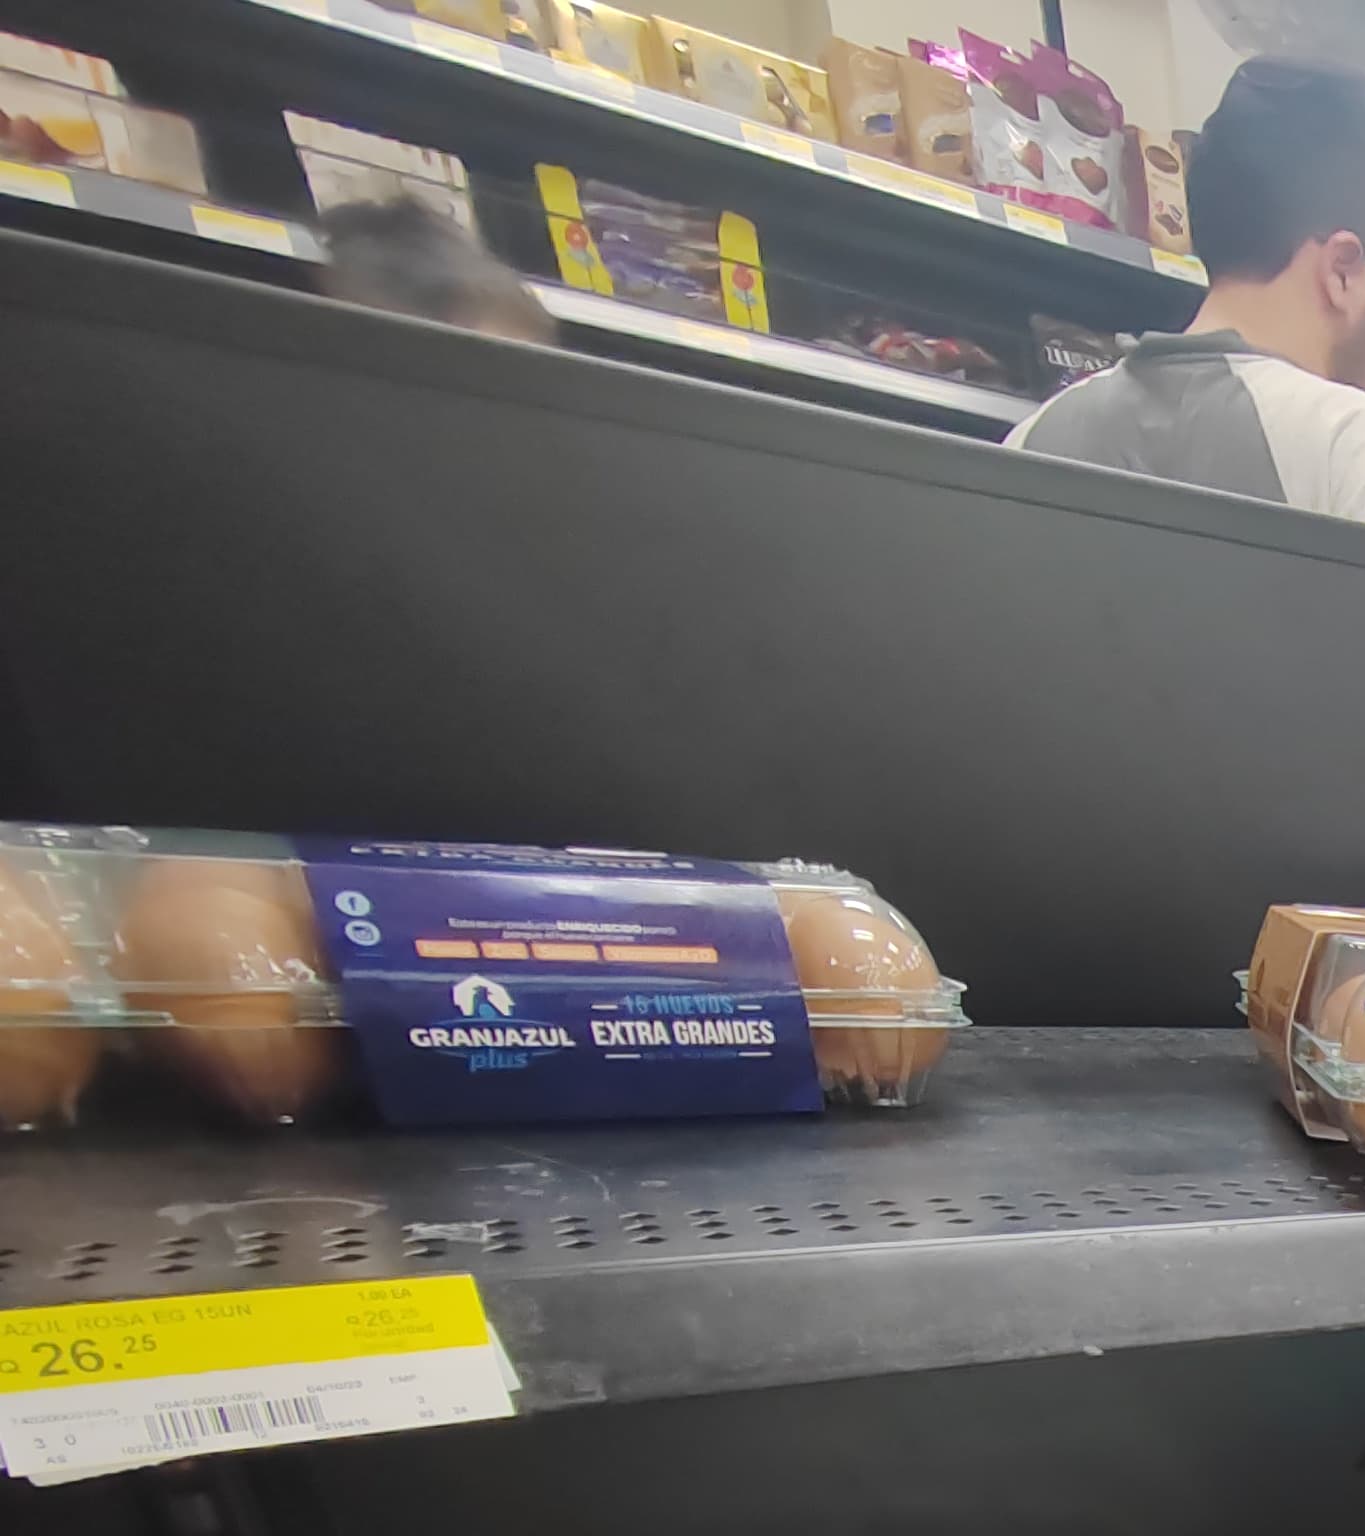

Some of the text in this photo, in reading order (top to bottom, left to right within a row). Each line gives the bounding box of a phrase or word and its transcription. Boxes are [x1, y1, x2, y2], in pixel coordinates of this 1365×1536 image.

[409, 1026, 577, 1049] GRANJAZUL
[591, 1020, 776, 1048] EXTRA GRANDES
[468, 1048, 530, 1074] plus
[74, 1312, 146, 1331] ROSA
[152, 1308, 186, 1325] EG
[194, 1303, 254, 1321] 15UN
[0, 1359, 21, 1374] Q
